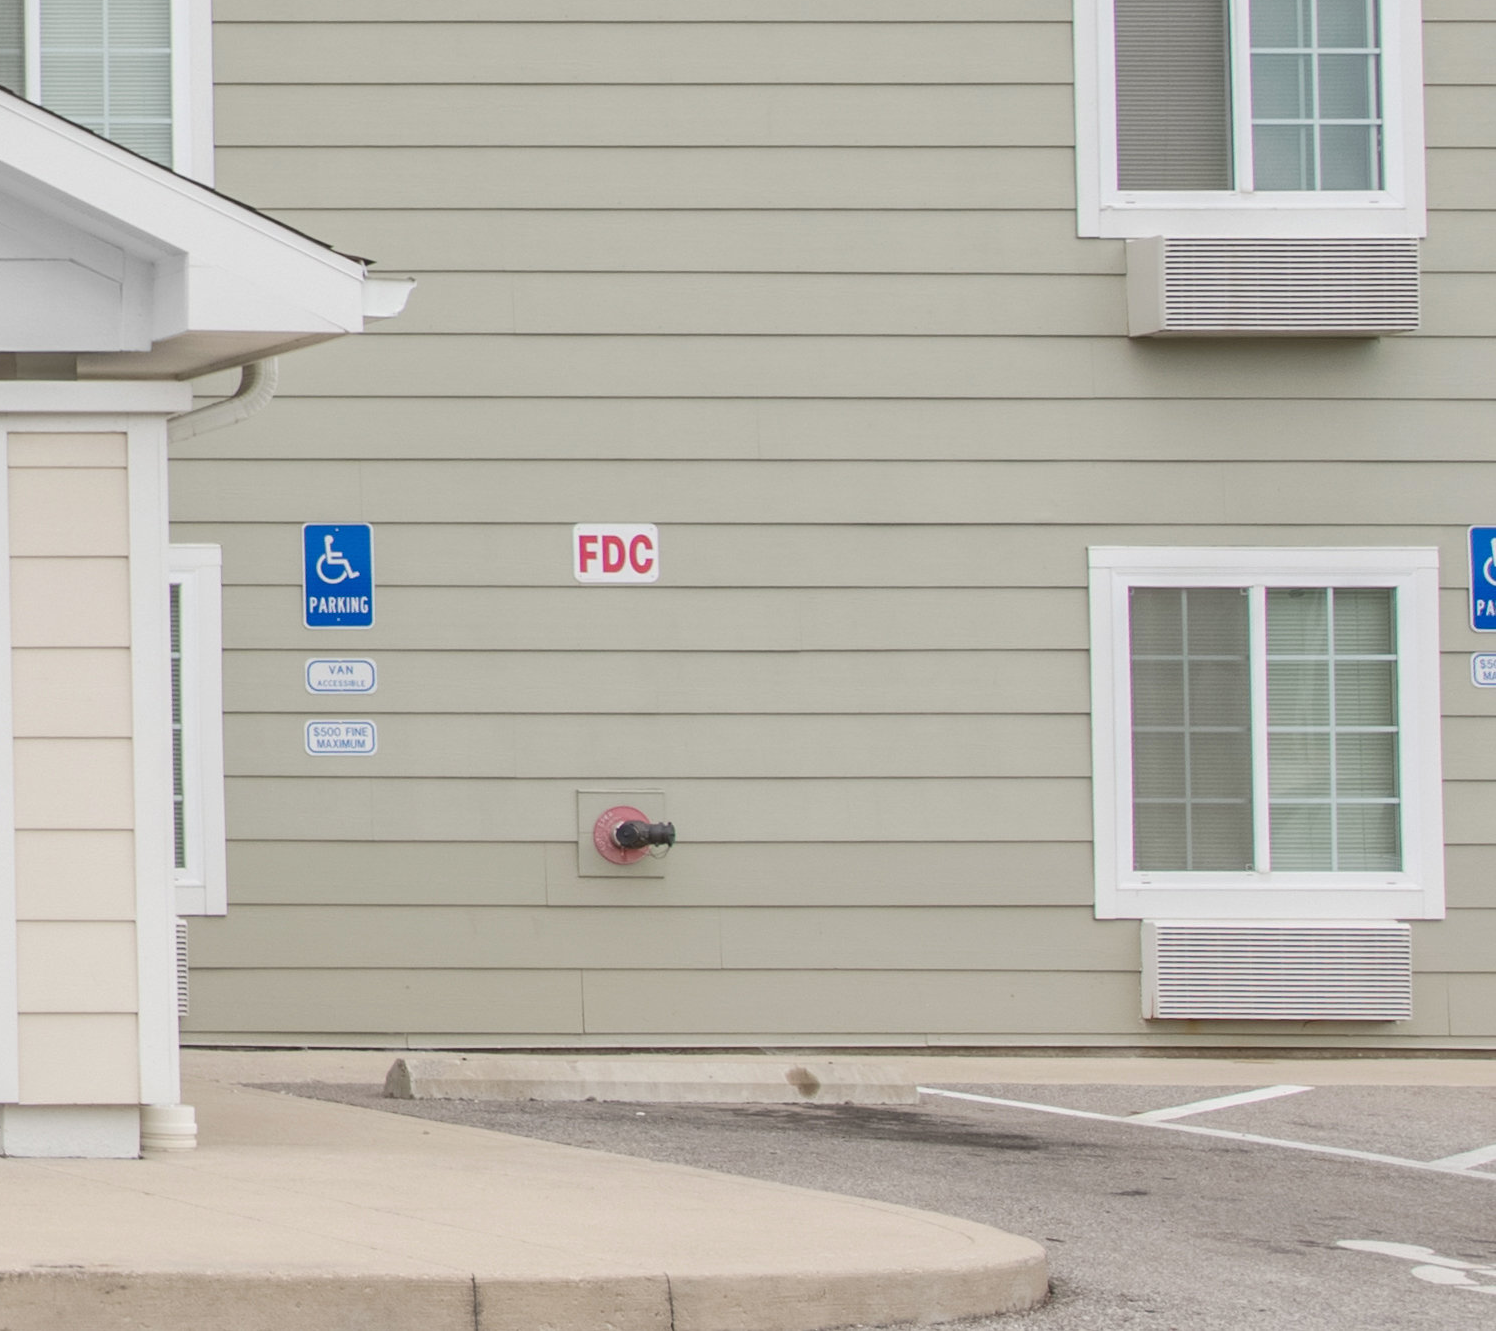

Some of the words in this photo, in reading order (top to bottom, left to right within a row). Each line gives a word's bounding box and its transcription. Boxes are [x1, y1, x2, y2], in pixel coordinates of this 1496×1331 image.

[578, 534, 654, 574] FDC
[309, 596, 369, 614] PARKING
[1476, 599, 1496, 616] PA
[328, 665, 354, 675] VAN
[317, 679, 366, 687] ACCESSIBLE
[313, 727, 342, 737] $500
[345, 727, 369, 737] FINE
[316, 739, 366, 749] MAXIMUM
